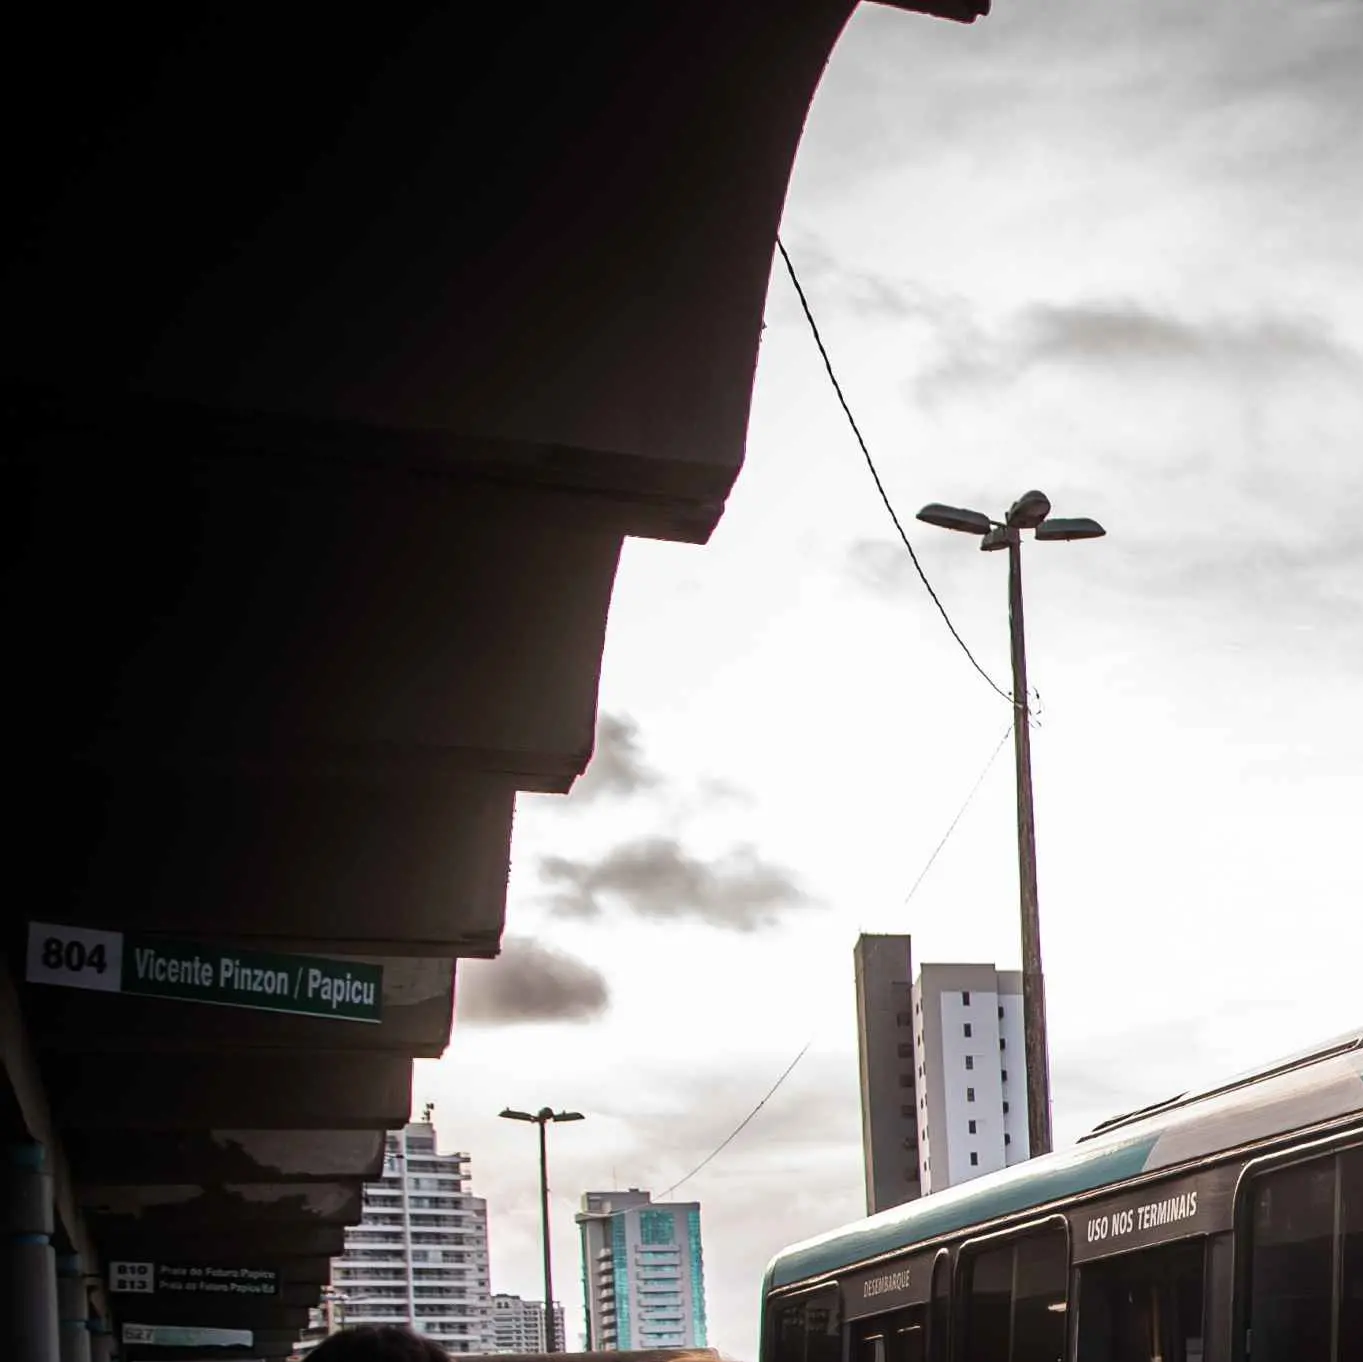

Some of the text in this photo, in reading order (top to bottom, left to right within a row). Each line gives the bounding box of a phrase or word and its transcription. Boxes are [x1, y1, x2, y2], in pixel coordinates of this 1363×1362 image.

[41, 937, 107, 974] 804
[134, 947, 215, 987] Vicente
[219, 957, 289, 996] Pinzon
[308, 968, 375, 1009] Papicu
[1087, 1191, 1198, 1242] USO NOS TERMINAIS
[863, 1269, 910, 1298] DESEMBARQUE
